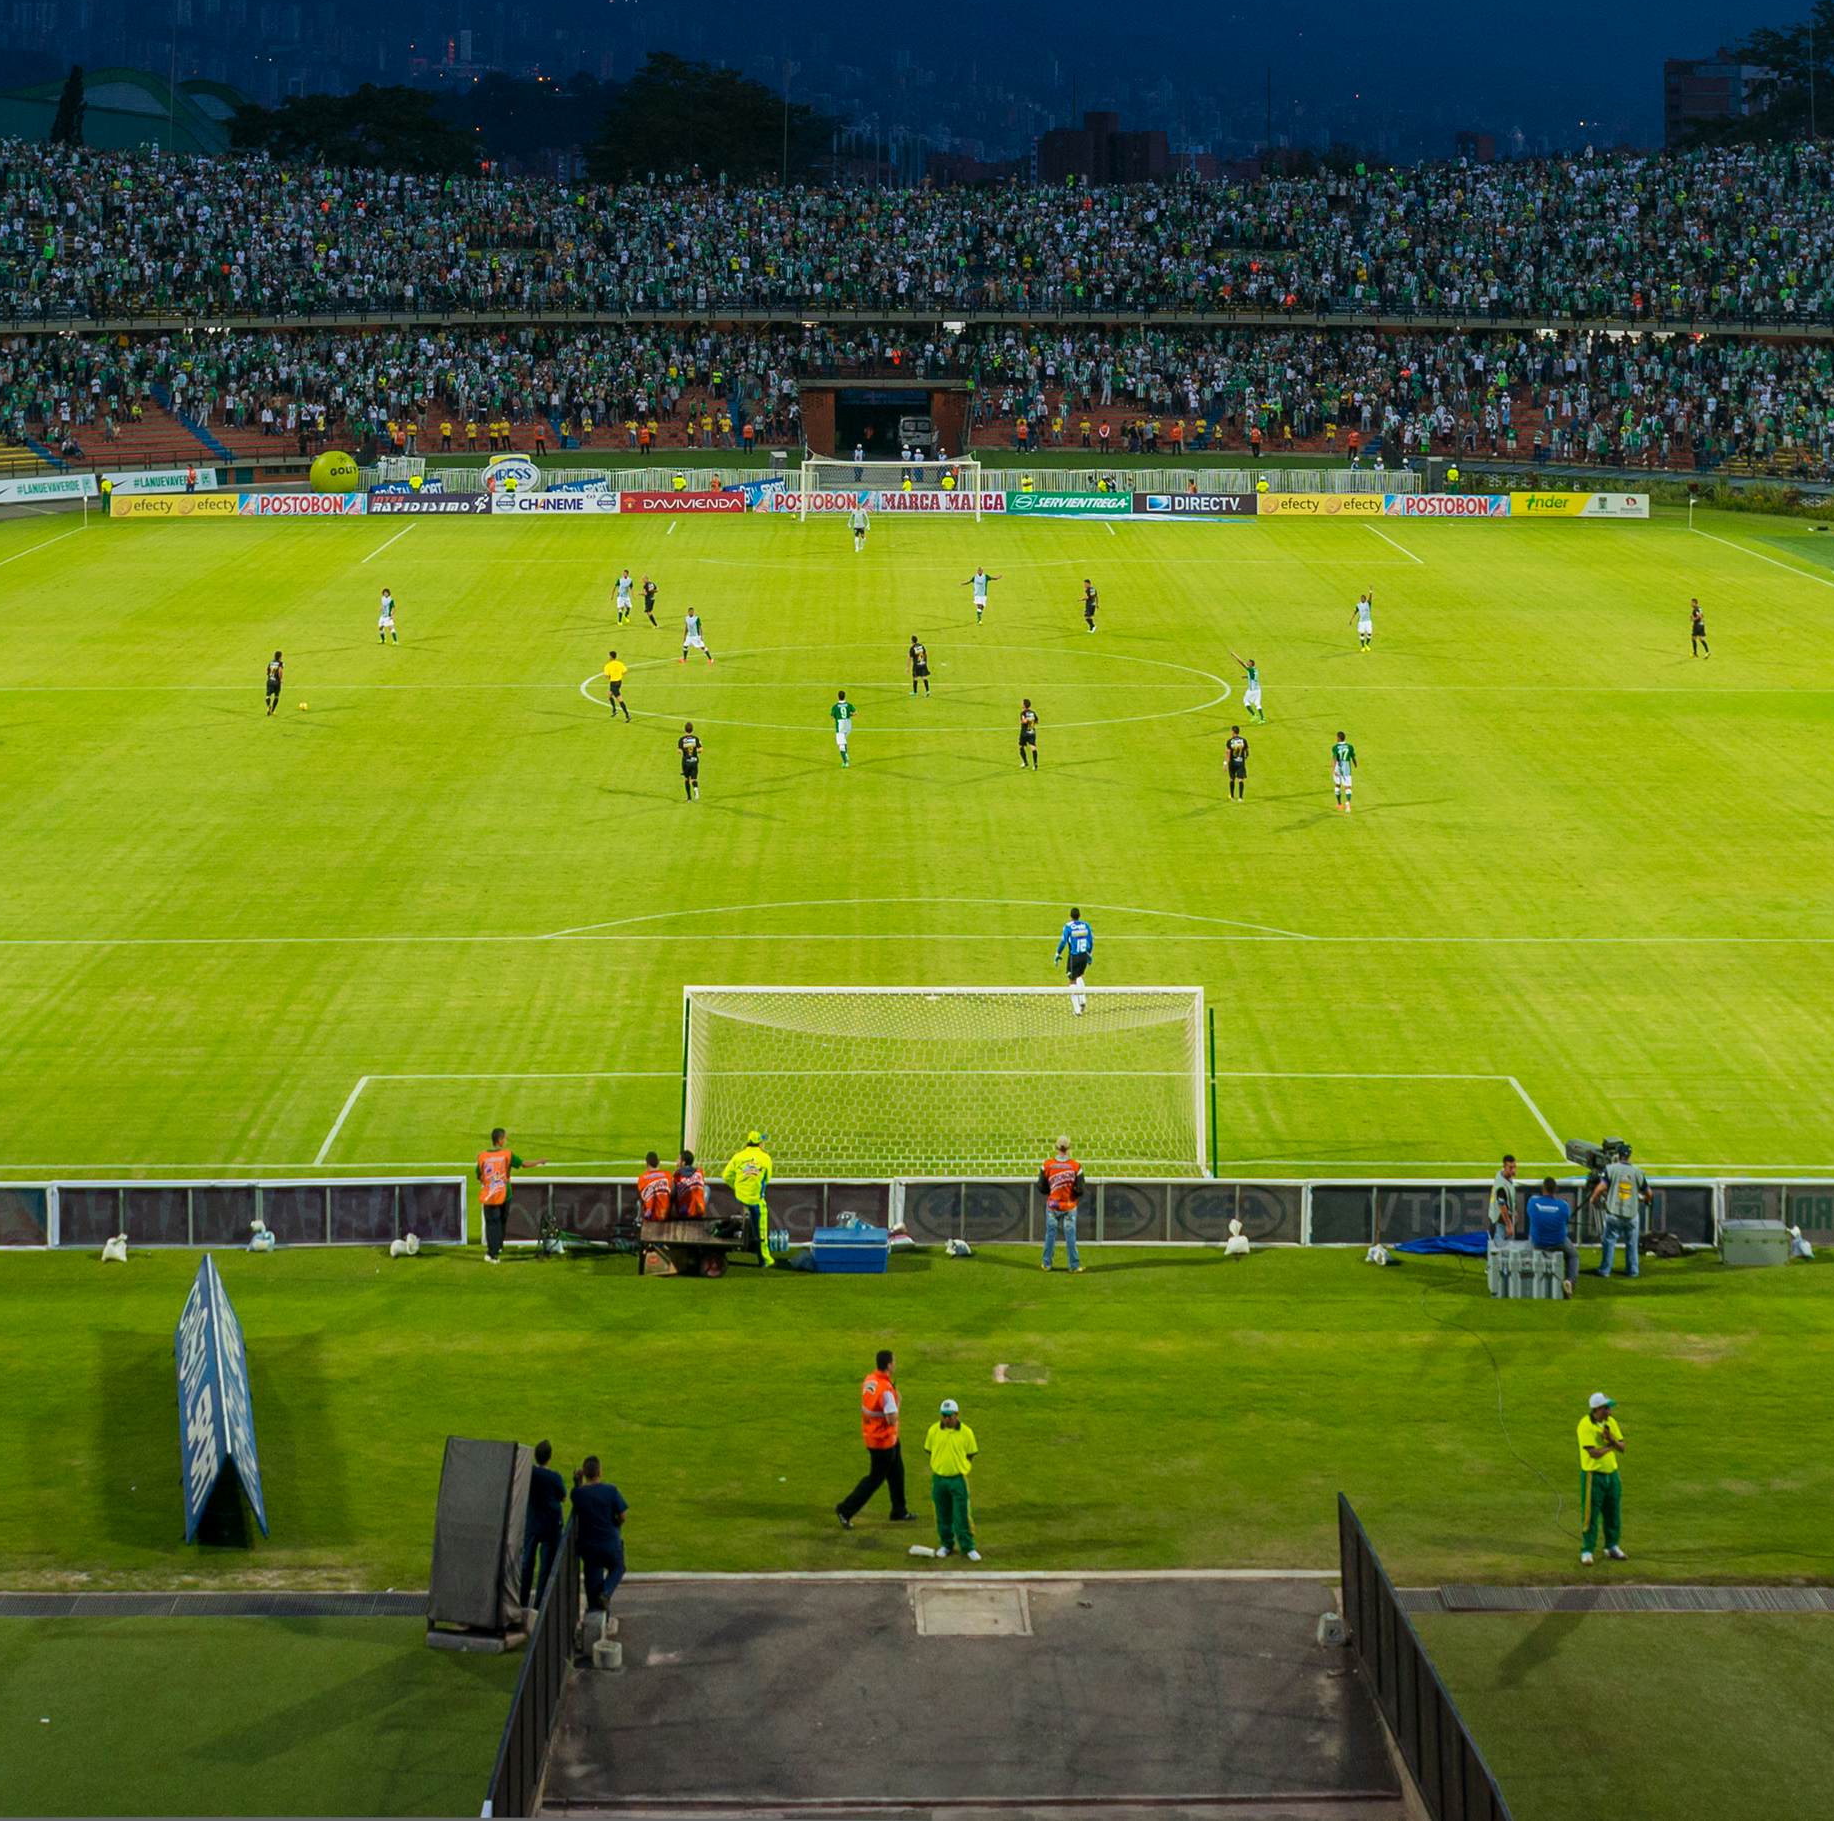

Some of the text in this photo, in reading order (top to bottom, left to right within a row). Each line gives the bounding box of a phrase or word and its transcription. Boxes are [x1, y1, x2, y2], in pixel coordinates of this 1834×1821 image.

[17, 480, 80, 495] #LANUEVAVERDE
[134, 497, 236, 514] efecty efecty
[260, 495, 343, 513] POSTOBON
[372, 502, 470, 512] RAPIDISIMO
[519, 498, 583, 510] CHANEME
[643, 498, 742, 509] DAVIVIENDA
[882, 493, 1004, 510] MARCA MARCA
[1035, 497, 1128, 508] SERVIENTREGA
[1174, 495, 1240, 511] DIRECTV
[1281, 498, 1383, 512] efecty efecty
[1405, 497, 1489, 515] POSTOBON
